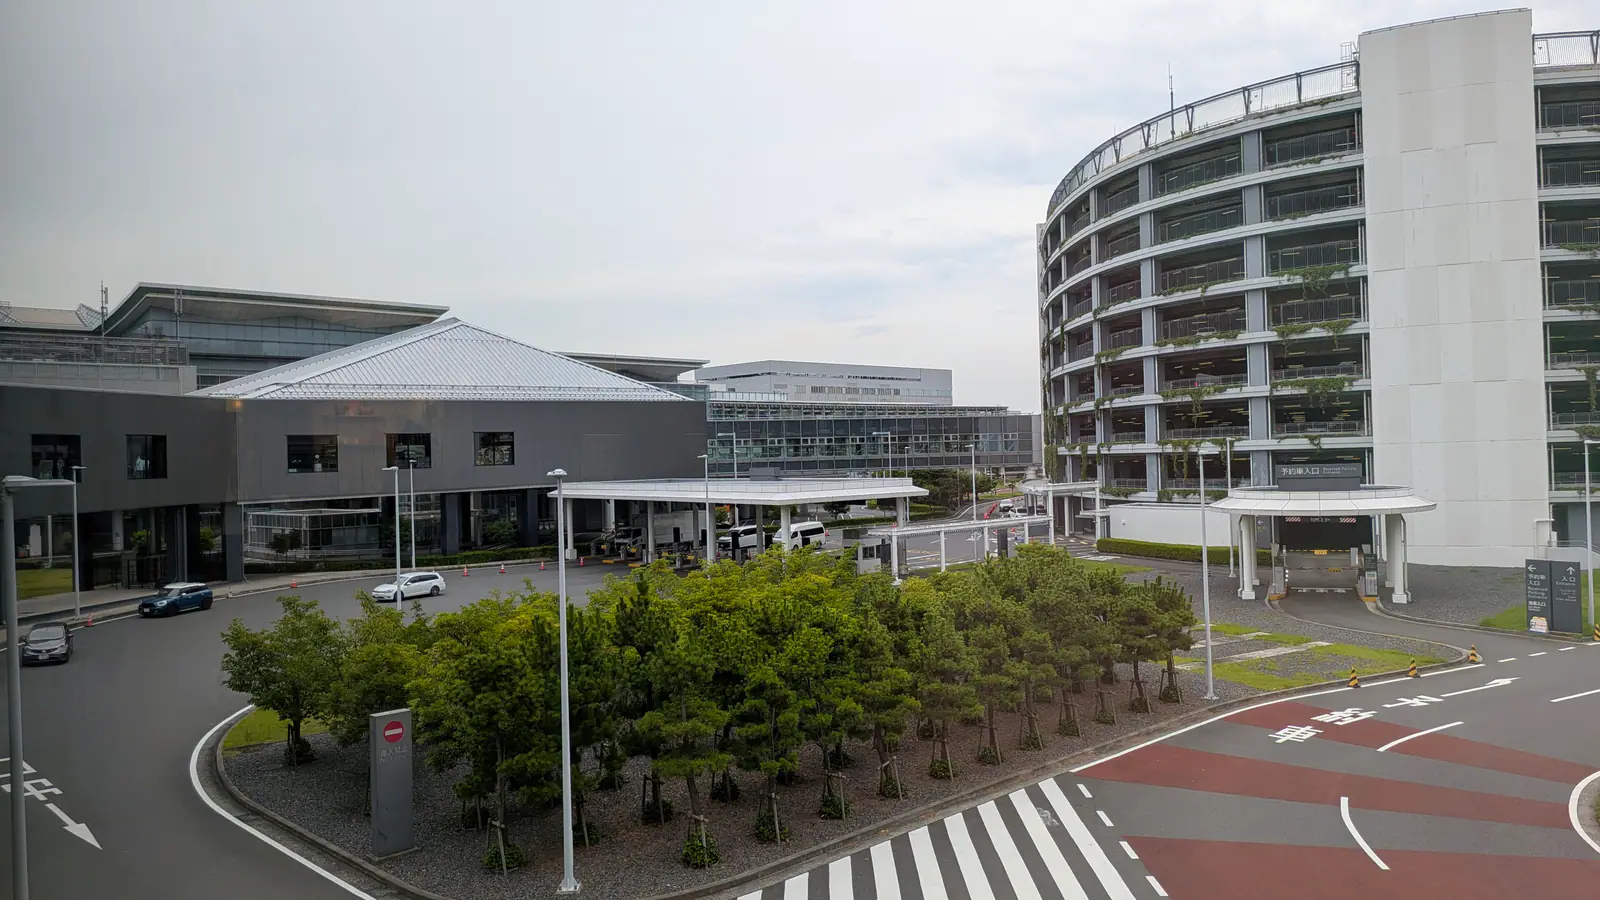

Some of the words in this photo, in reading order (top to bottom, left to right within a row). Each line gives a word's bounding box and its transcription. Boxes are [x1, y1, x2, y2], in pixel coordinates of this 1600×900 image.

[1280, 467, 1320, 476] 予約車入口
